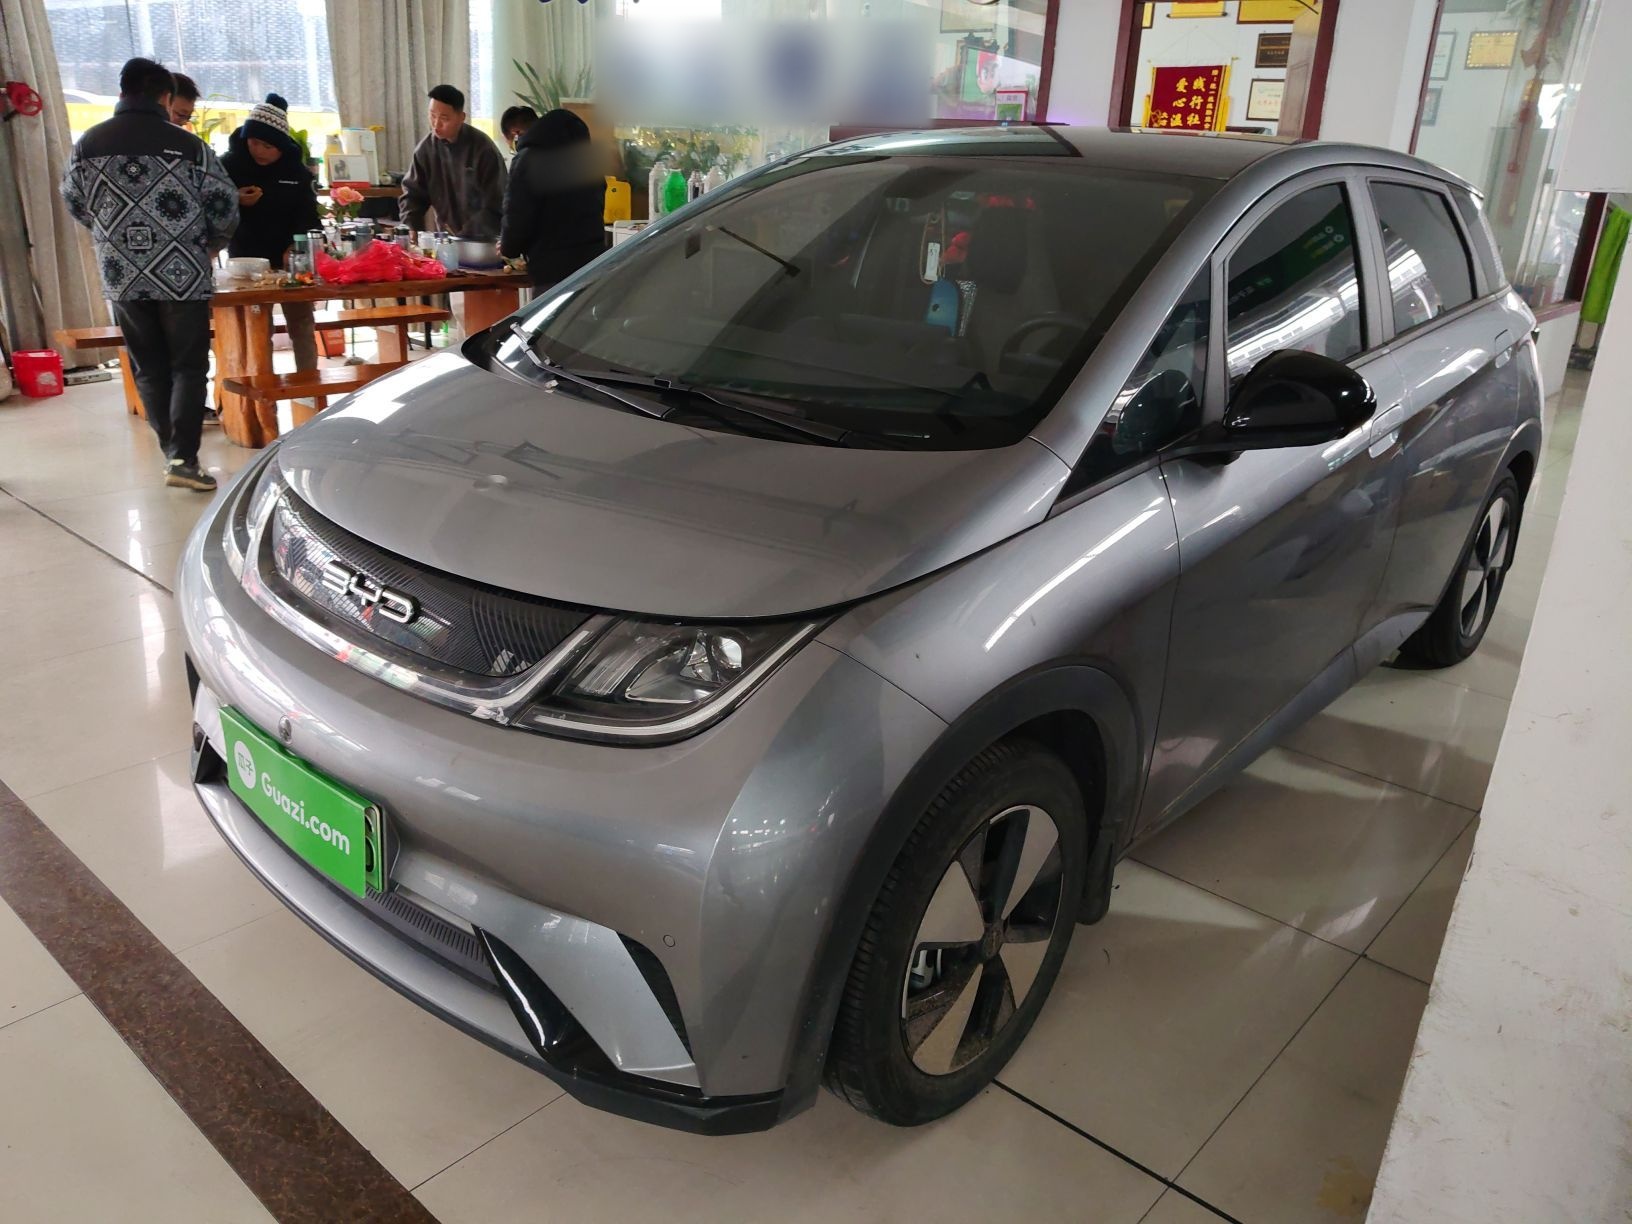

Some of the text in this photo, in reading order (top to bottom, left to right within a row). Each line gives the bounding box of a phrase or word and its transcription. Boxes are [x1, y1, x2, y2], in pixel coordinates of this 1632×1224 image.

[321, 560, 414, 623] BYD
[238, 752, 254, 776] 瓜子
[261, 772, 350, 855] Guazi.com
